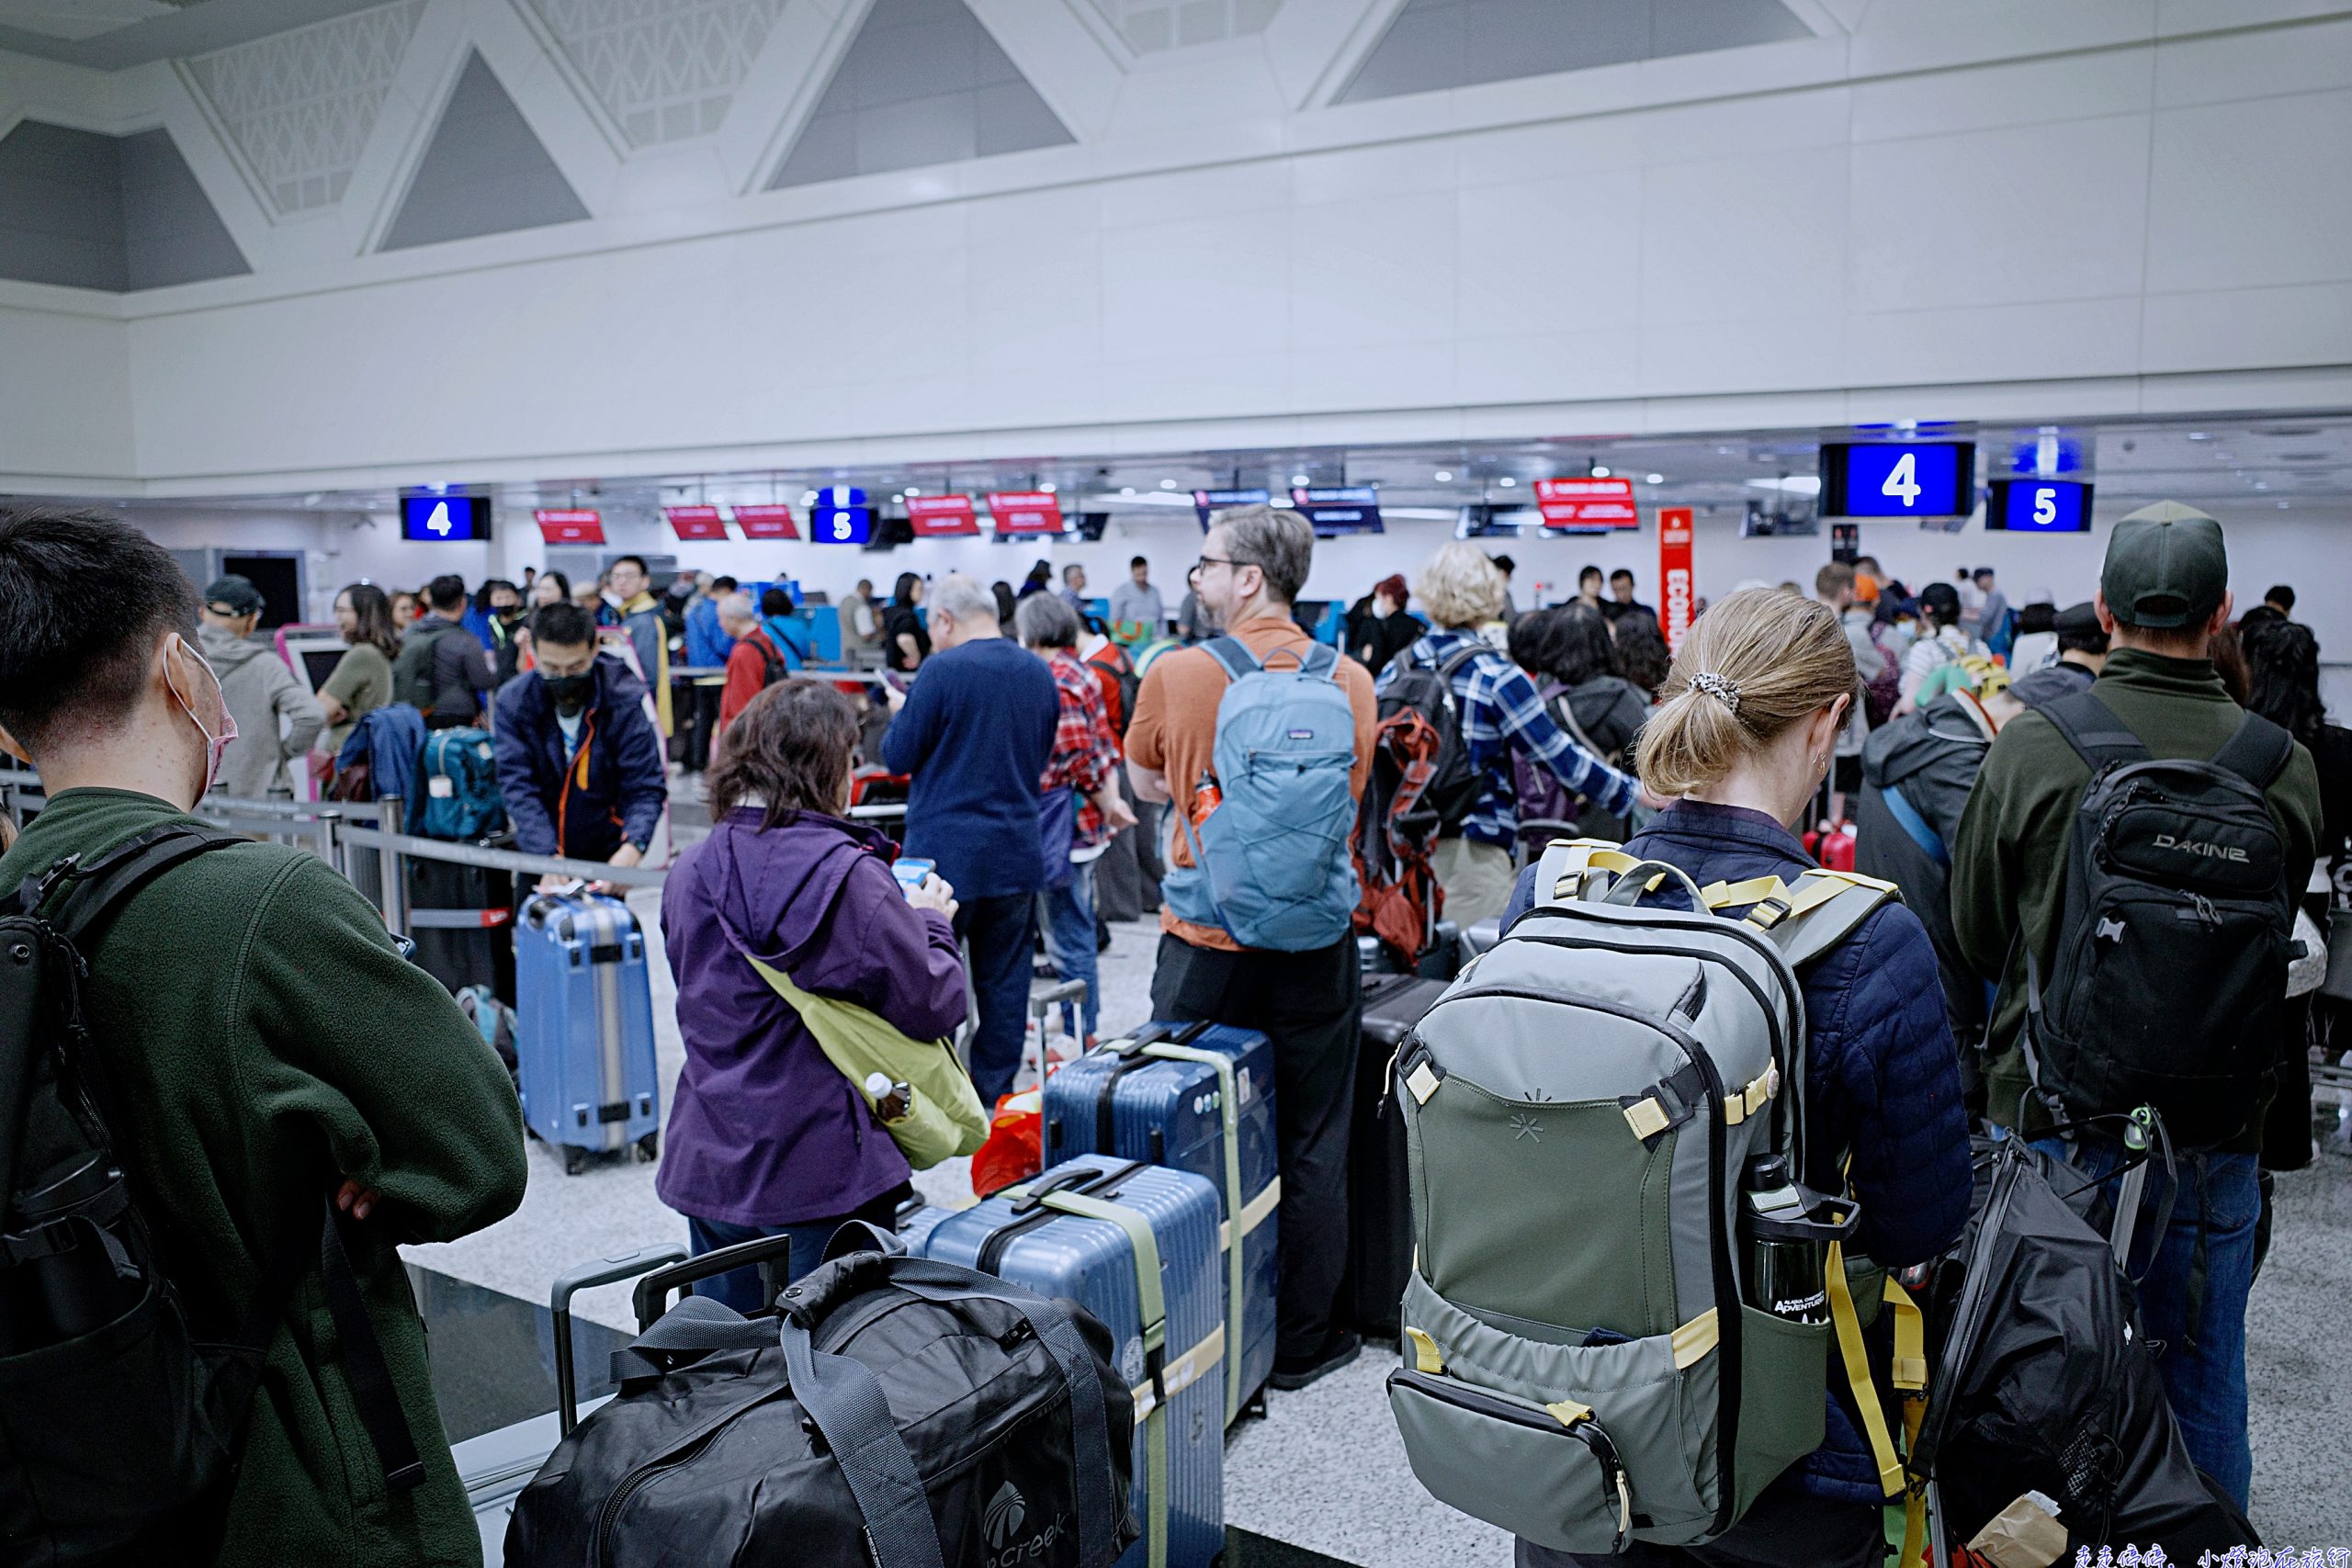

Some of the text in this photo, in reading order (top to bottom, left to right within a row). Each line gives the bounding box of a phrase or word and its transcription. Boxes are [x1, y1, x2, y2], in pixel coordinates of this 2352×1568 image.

[1882, 453, 1921, 507] 4
[426, 501, 452, 536] 4
[2033, 488, 2056, 525] 5
[833, 512, 852, 540] 5
[2152, 833, 2250, 863] DAKINE
